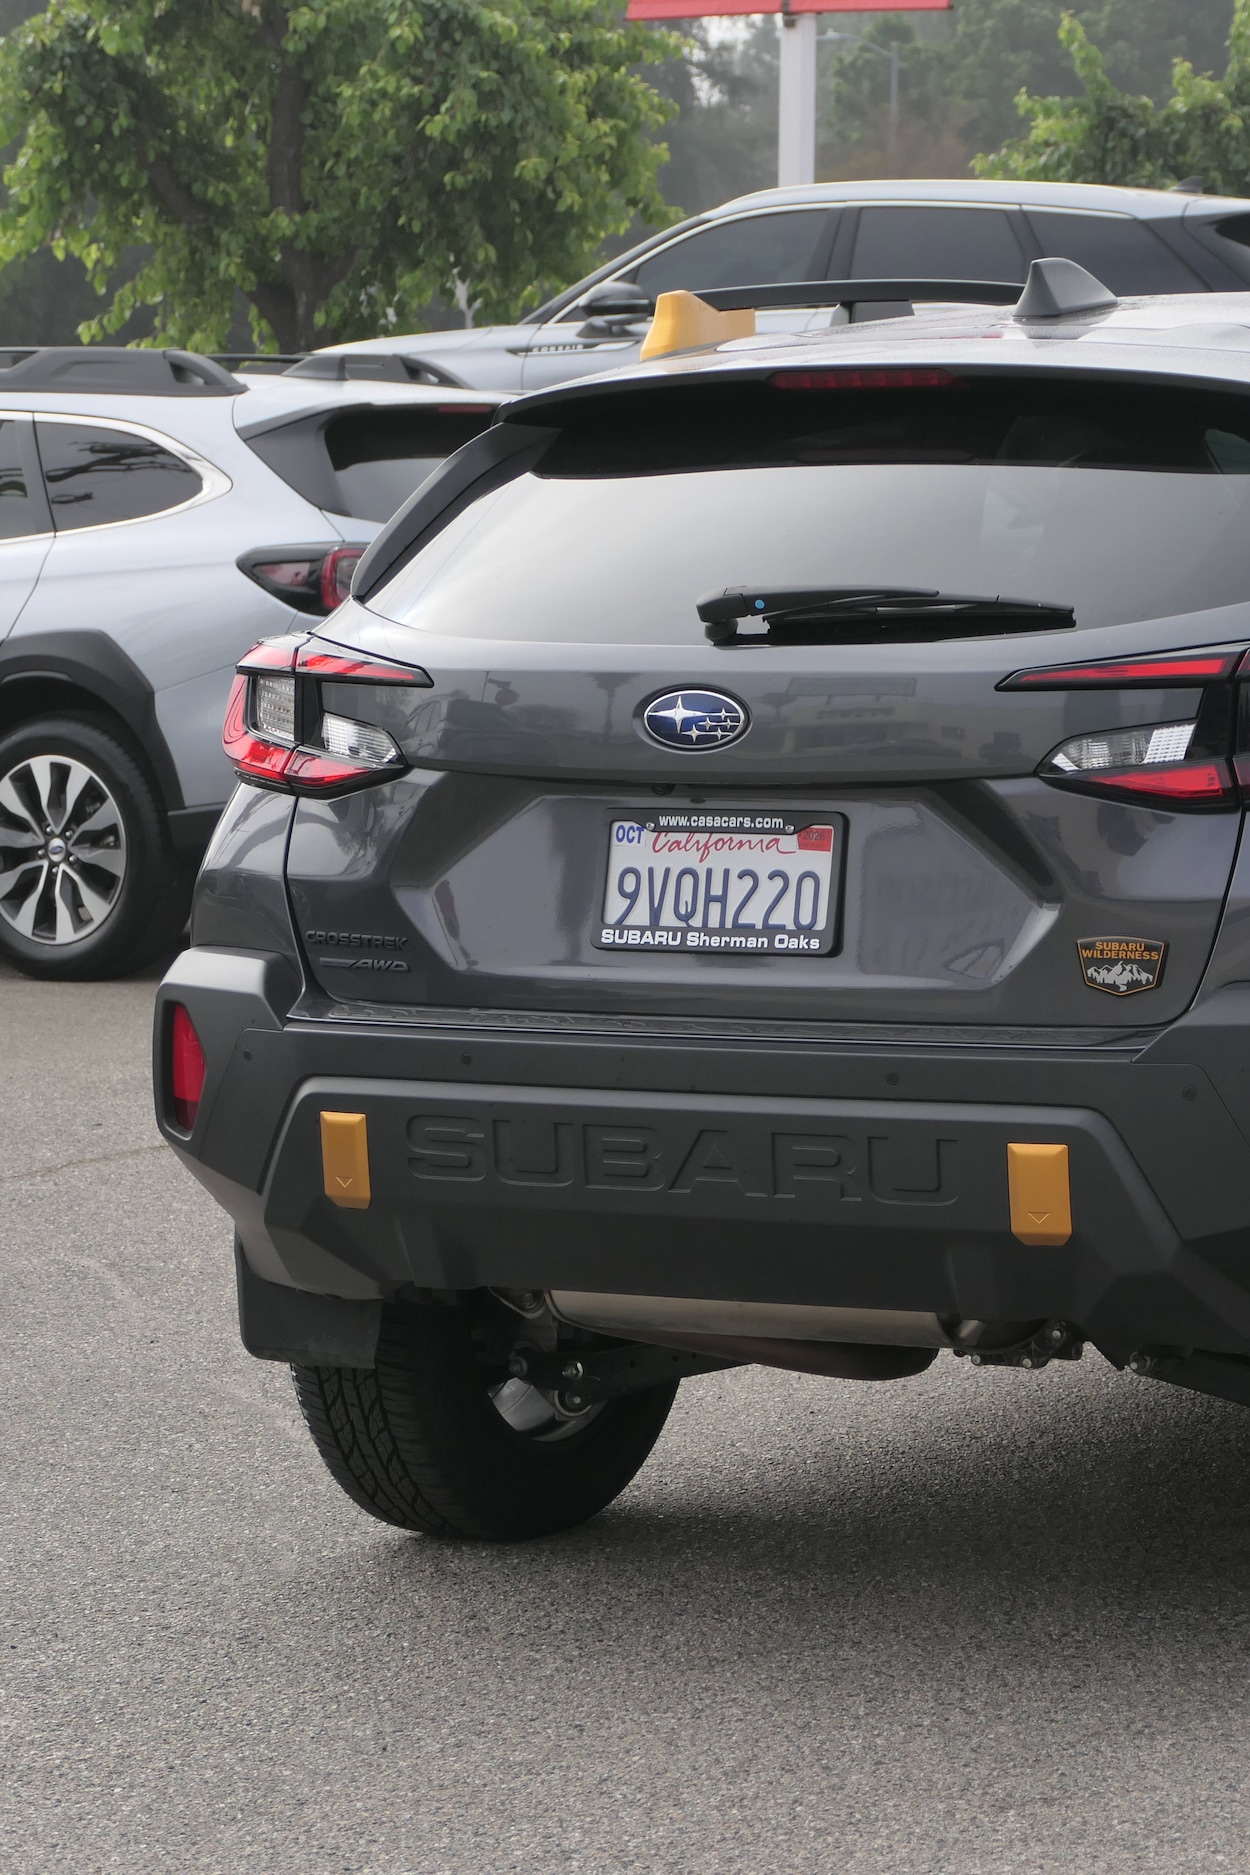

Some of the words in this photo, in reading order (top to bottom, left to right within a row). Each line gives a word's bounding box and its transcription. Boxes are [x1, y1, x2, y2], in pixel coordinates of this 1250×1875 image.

[658, 815, 784, 829] www.casacars.com
[615, 824, 645, 844] OCT
[803, 830, 826, 841] 2026
[651, 831, 797, 863] California
[613, 866, 821, 931] 9VQH220
[305, 930, 408, 950] CROSSTREK
[600, 929, 681, 945] SUBARU
[686, 931, 768, 949] Sherman
[774, 934, 821, 949] Oaks
[1095, 941, 1145, 951] SUBARU
[1082, 949, 1159, 960] WILDERNESS
[350, 958, 409, 972] AWD
[405, 1113, 959, 1207] SUBARU
